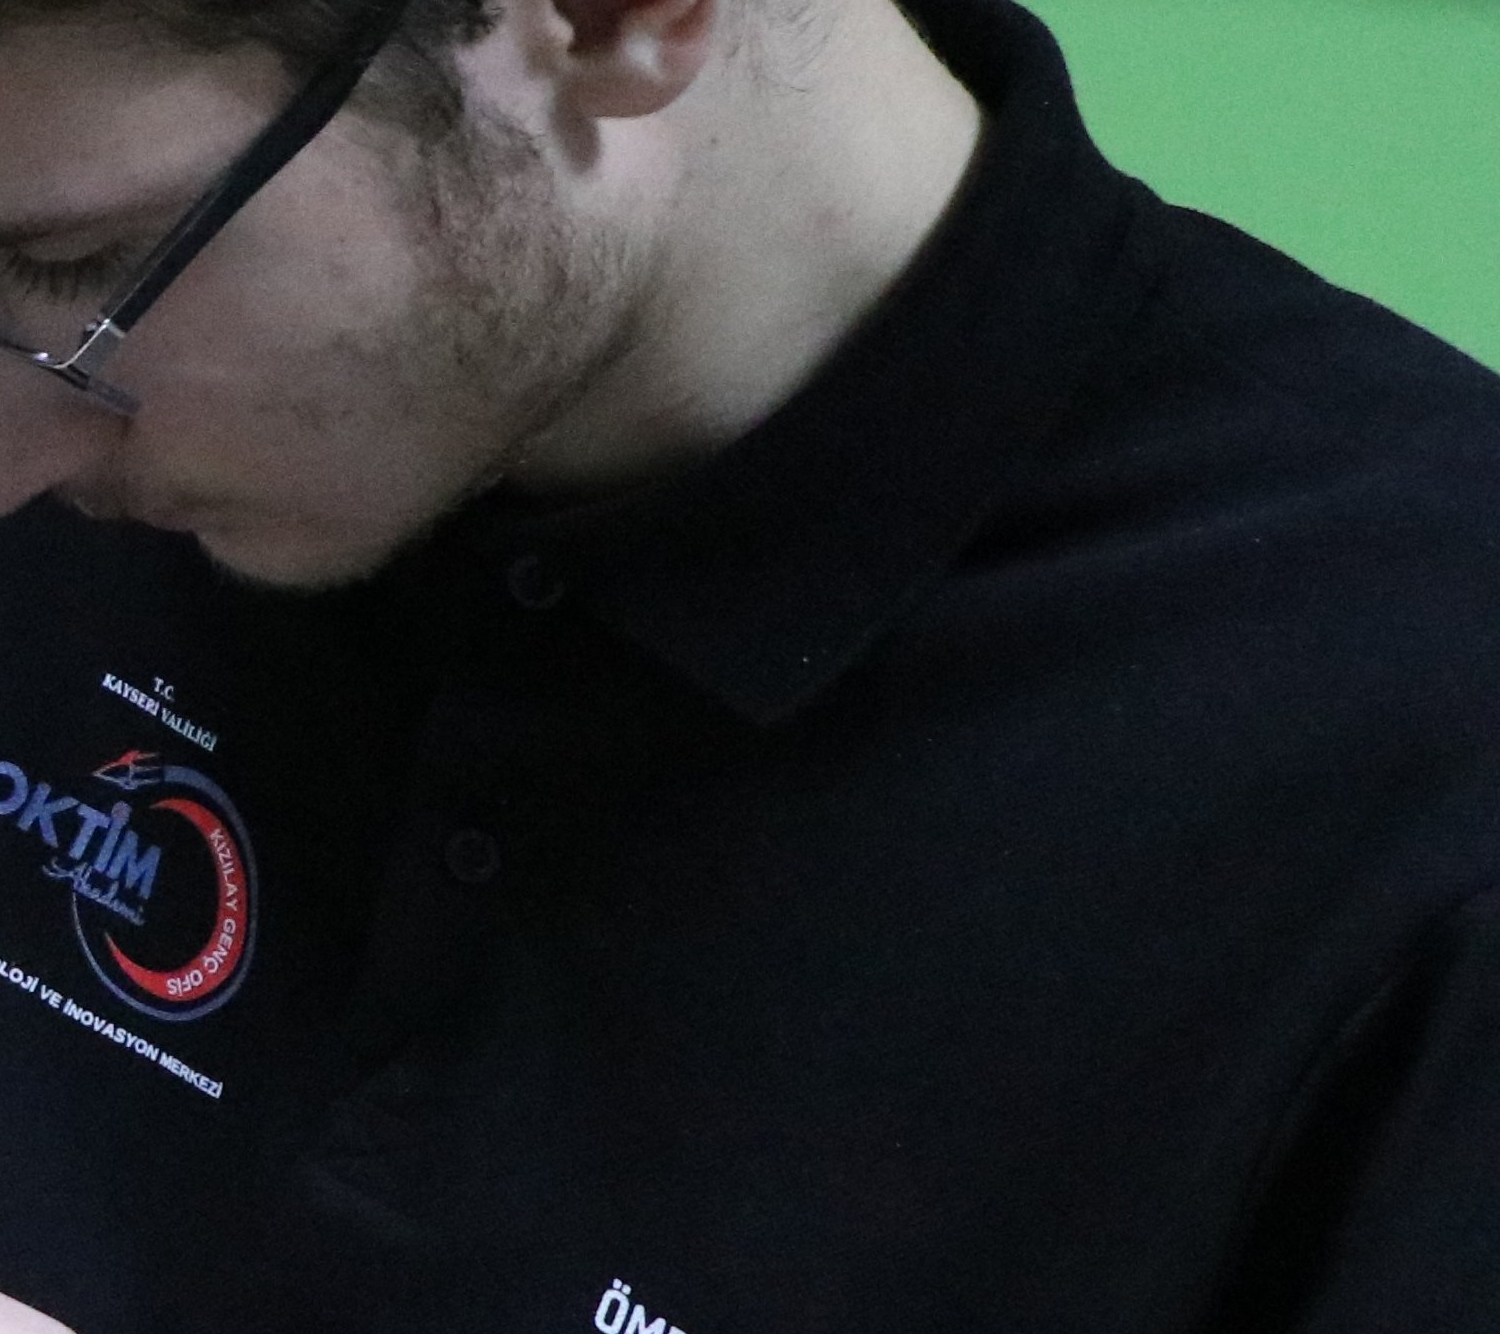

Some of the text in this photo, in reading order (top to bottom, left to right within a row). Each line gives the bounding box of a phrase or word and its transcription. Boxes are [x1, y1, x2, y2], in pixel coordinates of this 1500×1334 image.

[101, 672, 161, 717] KAYSERİ
[165, 828, 239, 997] KIZILAY GENÇ OFİS
[39, 983, 64, 1010] VE
[62, 997, 161, 1062] İNOVASYON
[157, 1051, 225, 1100] MERKEZİ
